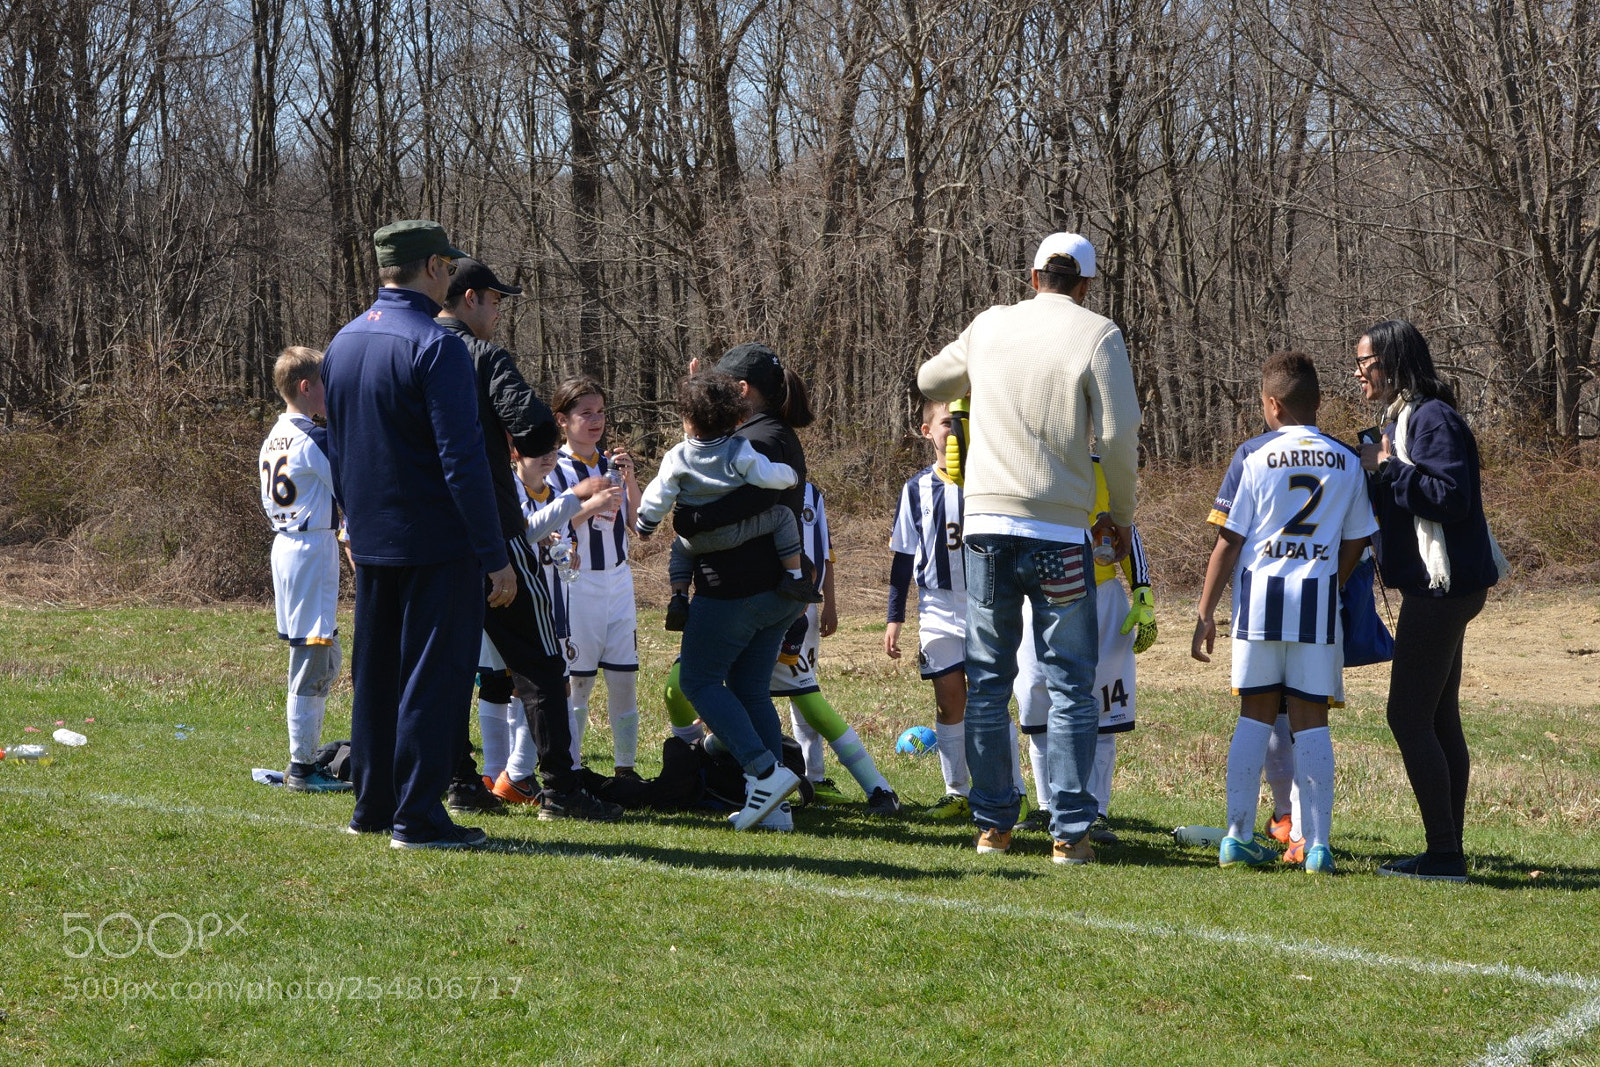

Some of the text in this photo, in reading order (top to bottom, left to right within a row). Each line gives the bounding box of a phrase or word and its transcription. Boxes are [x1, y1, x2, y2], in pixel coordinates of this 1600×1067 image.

[1266, 450, 1346, 471] GARRISON
[1281, 473, 1325, 538] 2
[1261, 540, 1330, 561] ALBA FC
[1101, 678, 1129, 713] 14
